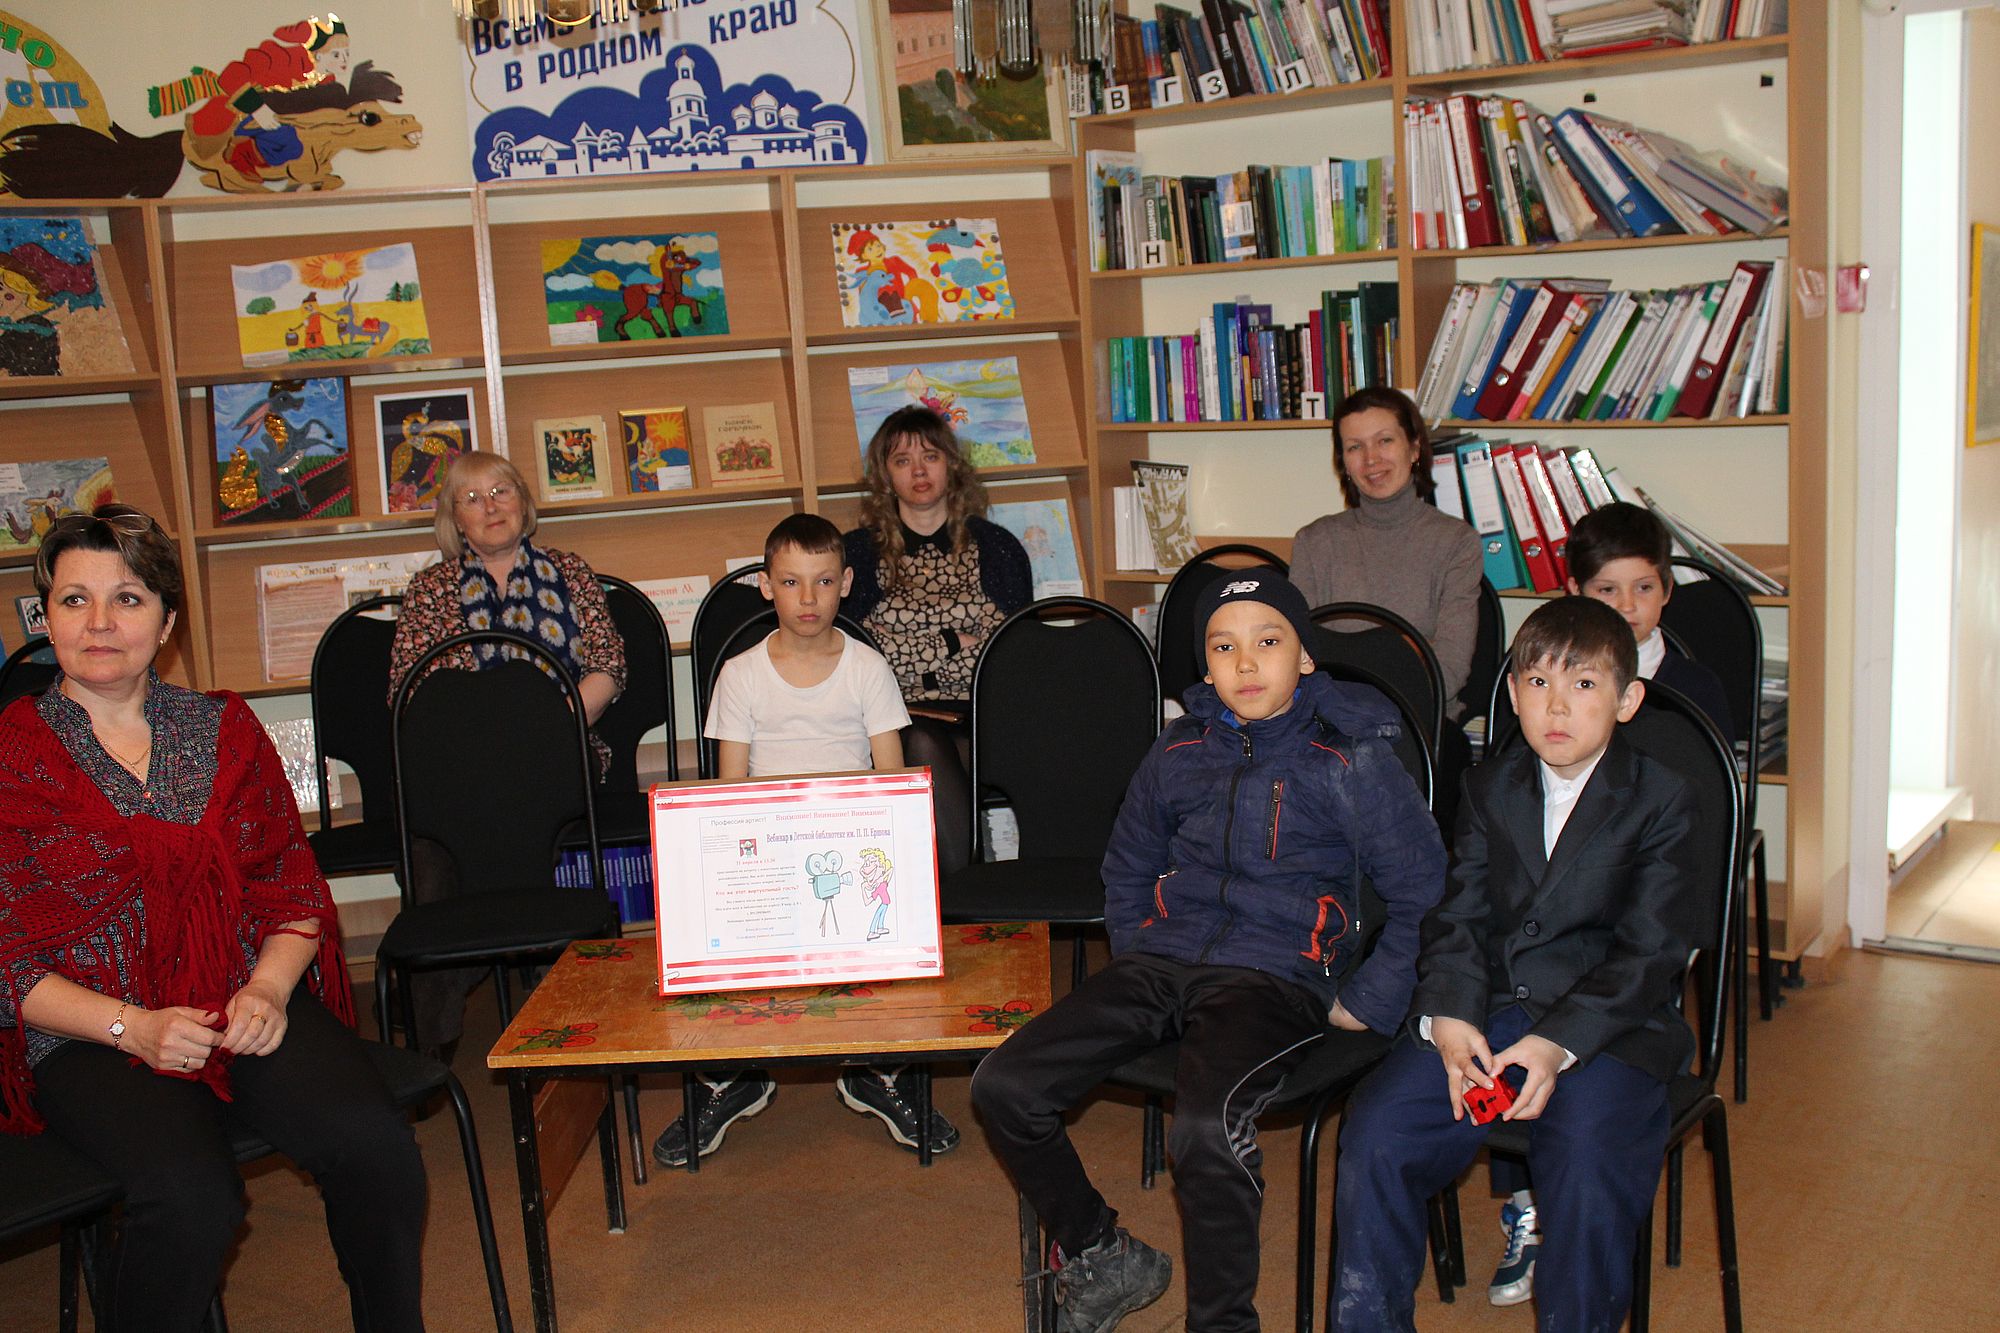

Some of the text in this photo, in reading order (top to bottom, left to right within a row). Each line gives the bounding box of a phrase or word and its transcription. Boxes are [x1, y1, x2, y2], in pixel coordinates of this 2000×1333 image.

[1111, 90, 1125, 109] В
[1146, 246, 1160, 264] Н
[1306, 398, 1319, 418] Т
